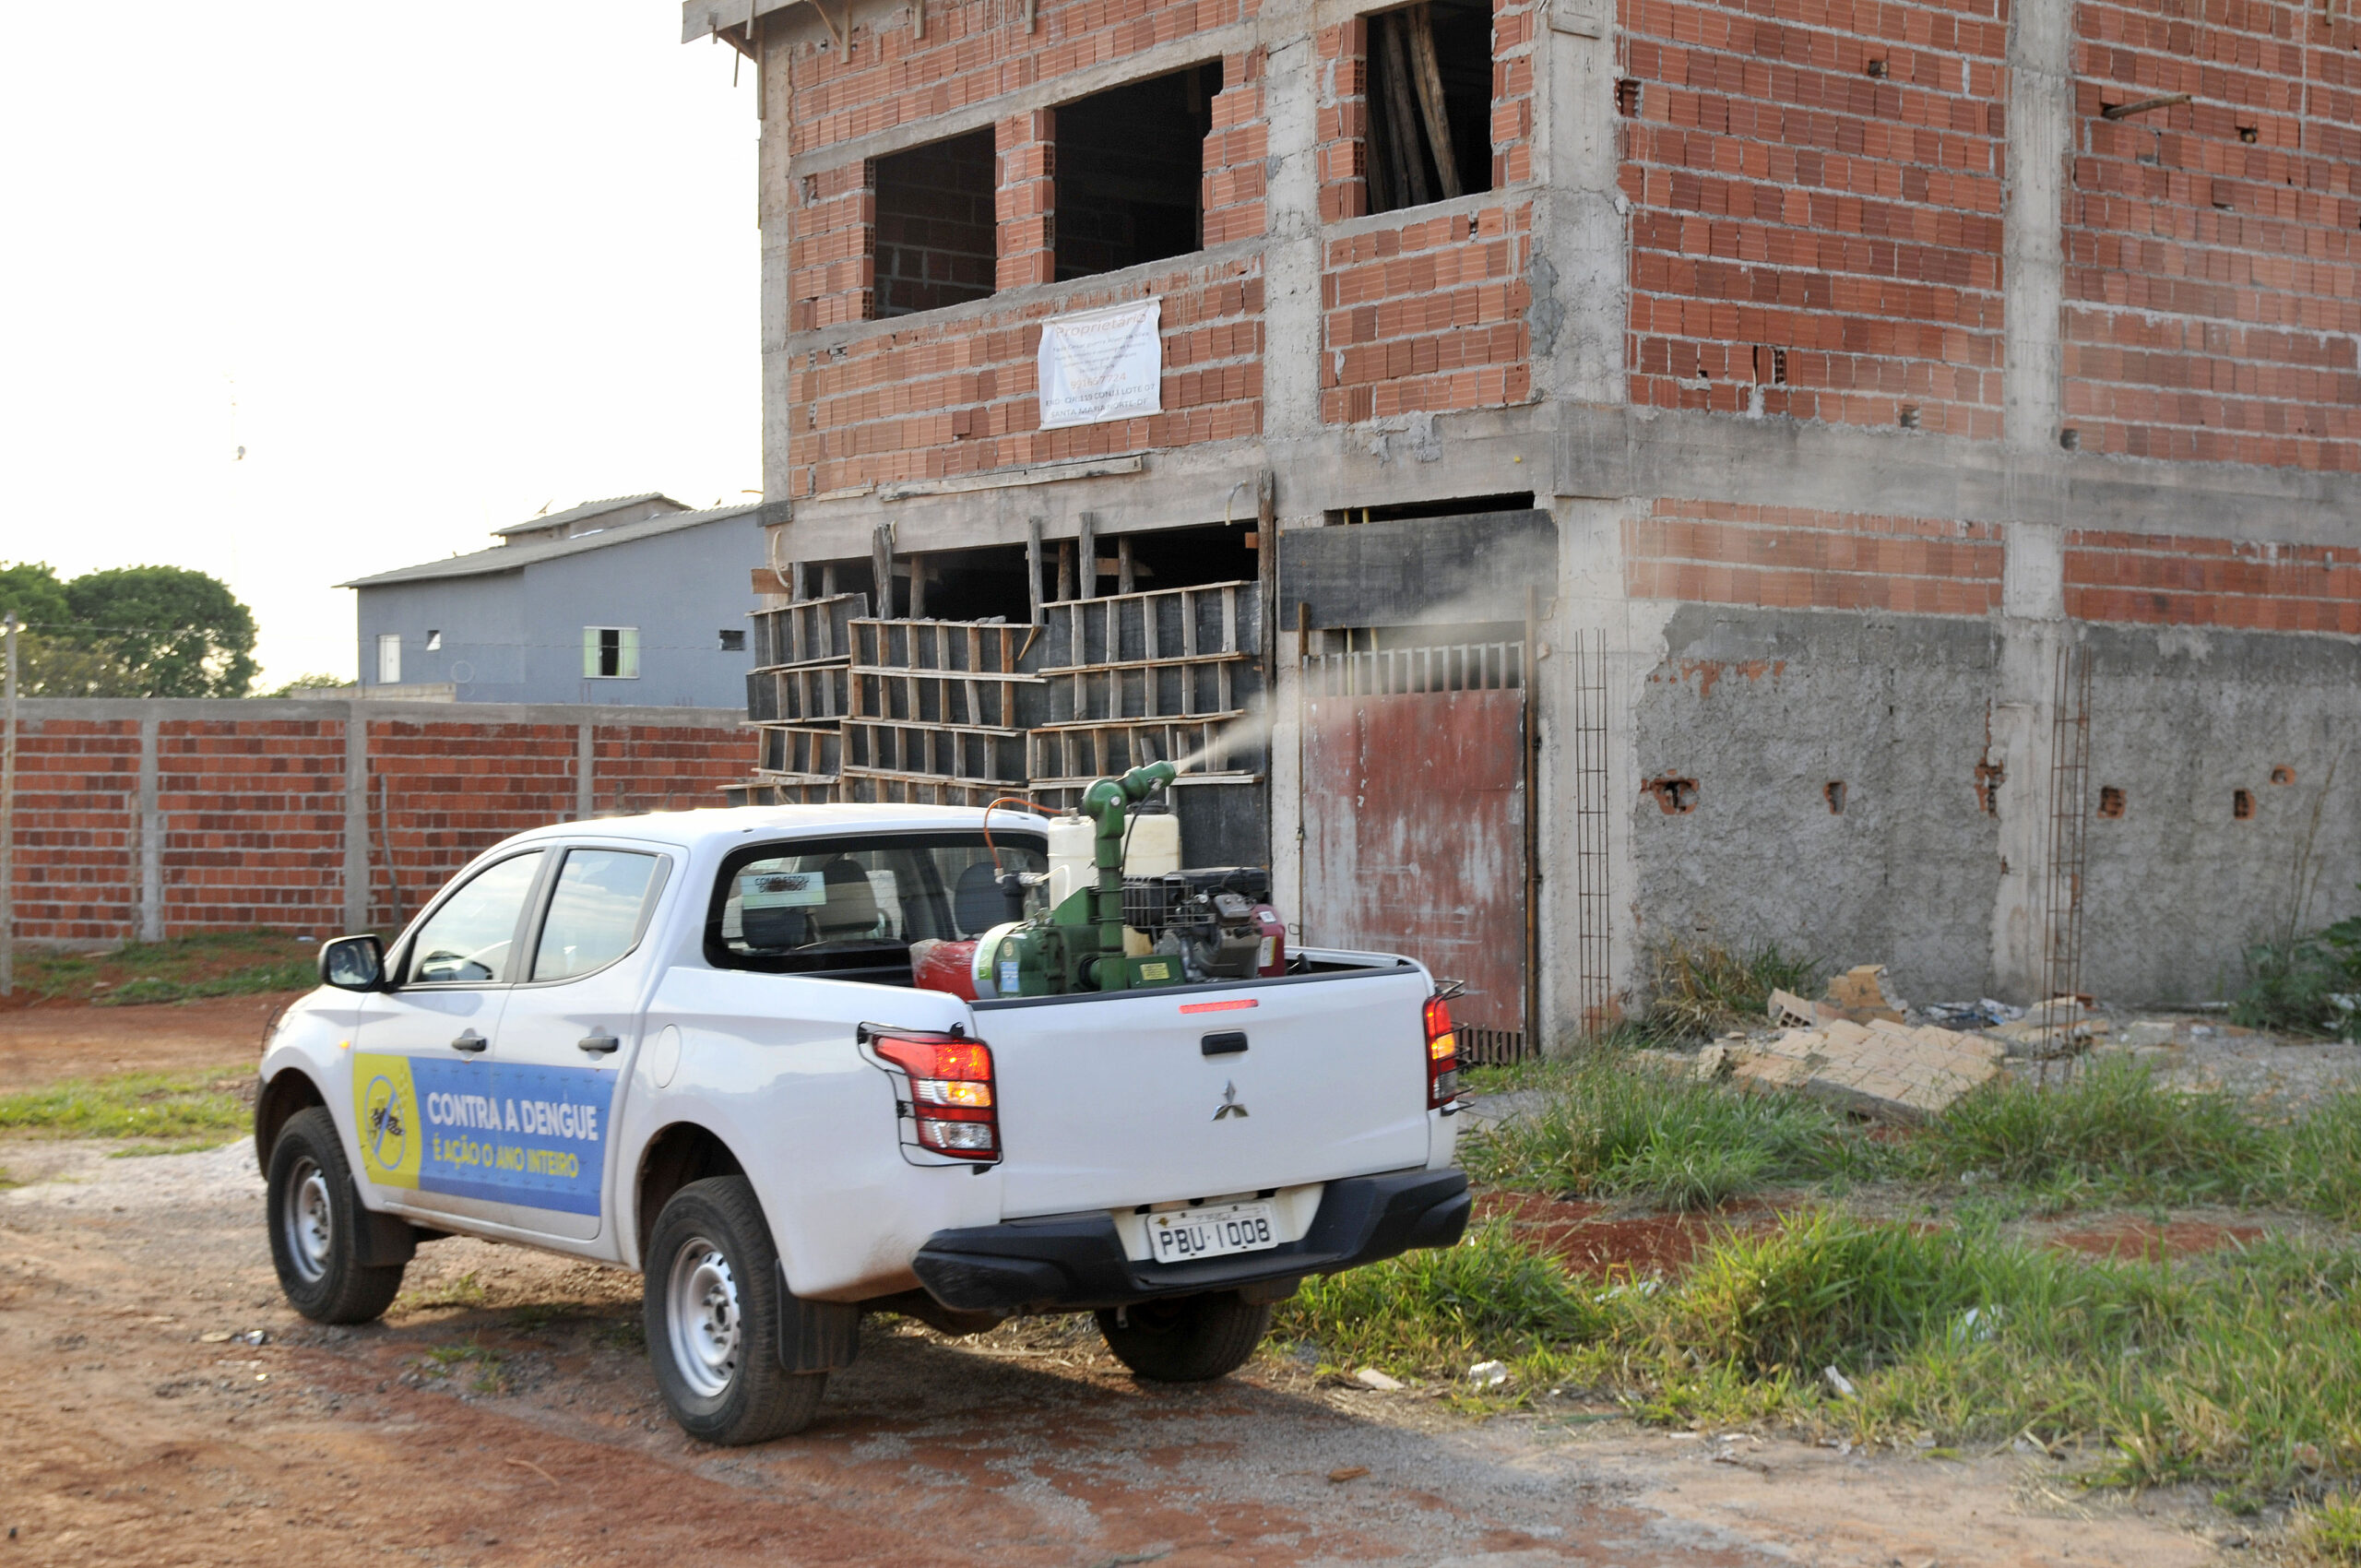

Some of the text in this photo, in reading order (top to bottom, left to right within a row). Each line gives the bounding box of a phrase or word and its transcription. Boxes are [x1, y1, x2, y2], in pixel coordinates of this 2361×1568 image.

[1055, 313, 1147, 339] Proprietário
[1051, 409, 1077, 418] SANTA
[1078, 405, 1105, 414] MARIA
[427, 1092, 599, 1141] CONTRA A DENGUE
[433, 1133, 579, 1179] É AÇÃO O ANO INTEIRO
